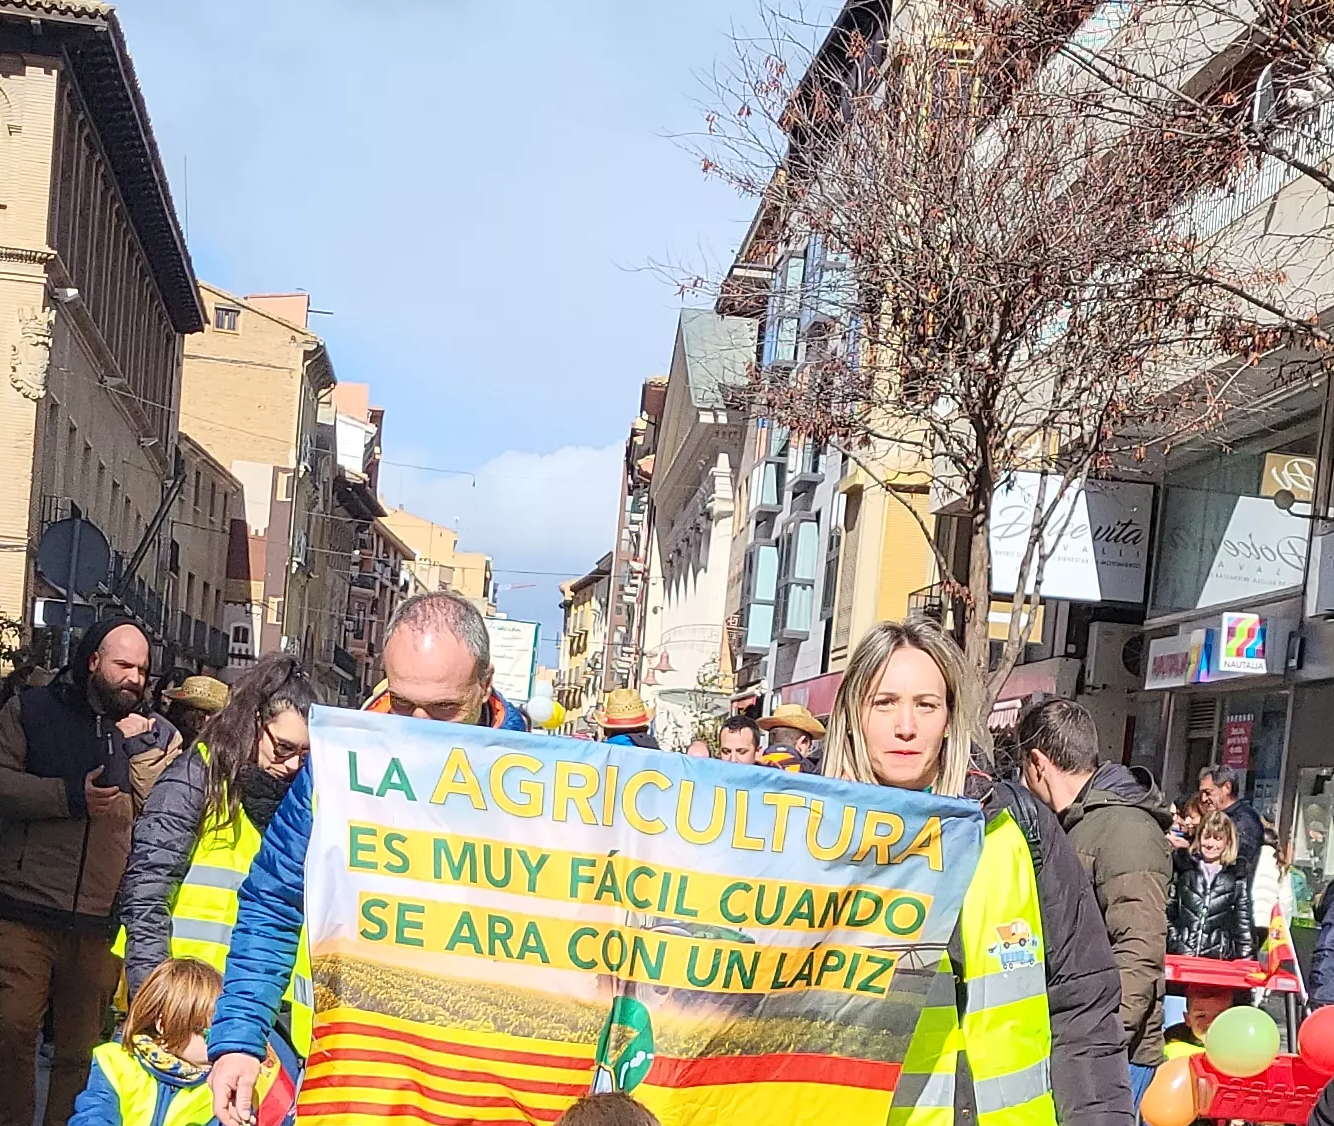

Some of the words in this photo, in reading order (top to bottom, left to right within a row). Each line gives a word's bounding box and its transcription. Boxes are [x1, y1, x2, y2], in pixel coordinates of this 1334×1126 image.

[991, 504, 1089, 541] Dlce
[1093, 518, 1144, 546] vita
[1223, 659, 1265, 670] NAUTALIA
[347, 750, 418, 802] LA
[429, 747, 945, 872] AGRICULTURA
[348, 824, 411, 874] ES
[432, 837, 551, 893] MUY
[569, 849, 700, 918] FÁCIL
[719, 881, 927, 936] CUANDO
[359, 897, 426, 948] SE
[444, 910, 551, 965] ARA
[567, 926, 668, 981] CON
[685, 944, 762, 990] UN
[770, 940, 895, 994] LÁPIZ
